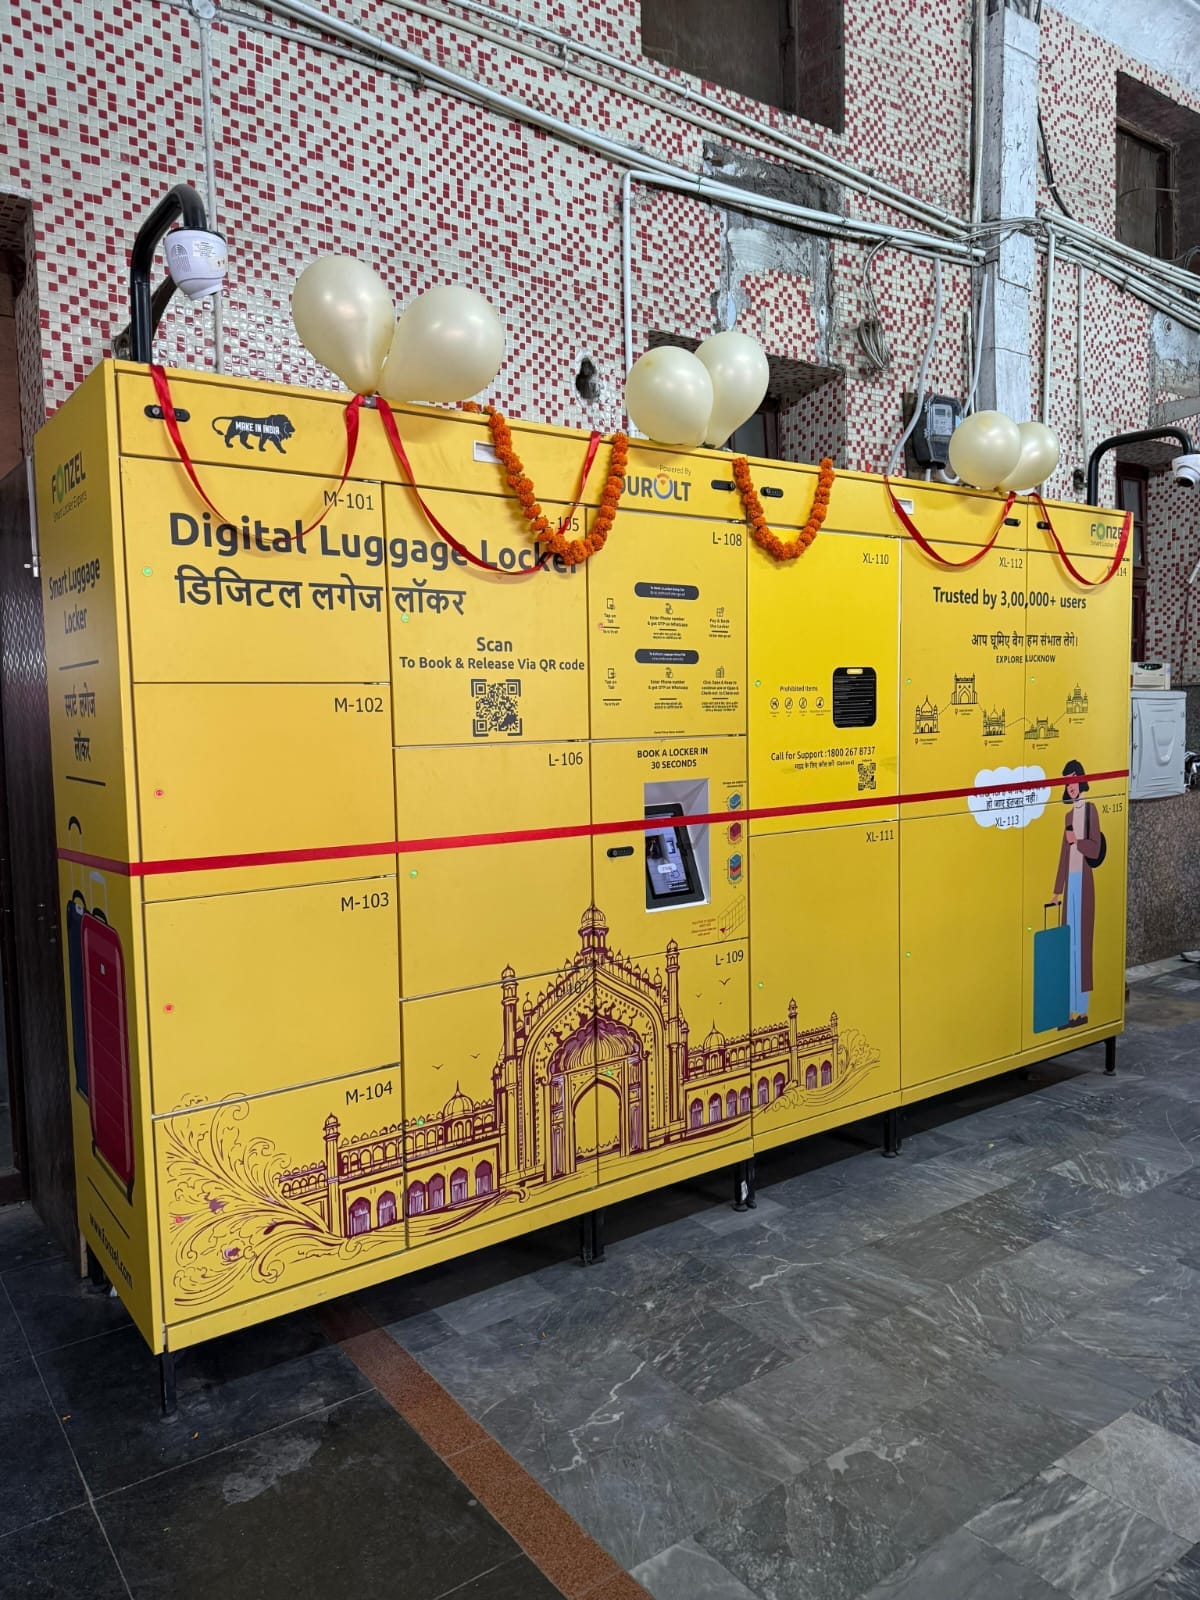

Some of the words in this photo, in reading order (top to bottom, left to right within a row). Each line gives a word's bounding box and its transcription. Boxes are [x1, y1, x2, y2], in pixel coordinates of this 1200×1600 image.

[235, 421, 254, 432] MAKE
[255, 423, 262, 433] IN
[263, 424, 280, 434] INDIA
[659, 464, 684, 475] Powered
[684, 467, 692, 477] By
[323, 490, 375, 511] M-101
[546, 516, 579, 532] -105
[1090, 522, 1124, 540] FONZE
[169, 511, 307, 557] Digital
[320, 525, 468, 571] Luggage
[712, 532, 743, 547] L-108
[862, 552, 889, 565] XL-110
[999, 556, 1023, 569] XL-112
[49, 570, 68, 601] Smart
[68, 557, 101, 595] Luggage
[174, 564, 303, 609] डिजिटल
[308, 573, 384, 613] लगेज
[391, 578, 467, 616] लॉकर
[933, 586, 979, 605] Trusted
[982, 588, 997, 610] by
[1000, 590, 1056, 609] 3,00,000+
[1060, 595, 1087, 609] users
[63, 602, 88, 635] Locker
[476, 636, 513, 653] Scan
[971, 633, 988, 647] आप
[990, 631, 1010, 650] घूमिए
[1012, 630, 1024, 647] बैग
[1025, 634, 1038, 648] हम
[1040, 632, 1061, 647] संभाल
[399, 656, 416, 669] To
[419, 656, 452, 669] Book
[455, 657, 464, 669] &
[468, 657, 515, 670] Release
[517, 658, 537, 670] Via
[539, 659, 556, 673] QR
[559, 659, 585, 671] code
[996, 655, 1024, 664] EXPLORE
[1024, 654, 1056, 663] LUCKNOW
[779, 685, 805, 693] Prohibited
[334, 697, 384, 713] M-102
[548, 751, 583, 767] L-106
[637, 749, 660, 758] BOOK
[661, 748, 668, 757] A
[669, 747, 699, 757] LOCKER
[700, 747, 708, 755] IN
[770, 752, 784, 761] Call
[785, 751, 796, 760] for
[797, 749, 824, 761] Support
[845, 747, 858, 757] 267
[859, 746, 876, 756] 8737
[651, 760, 661, 770] 30
[661, 758, 697, 769] SECONDS
[1102, 802, 1123, 814] XL-115
[995, 814, 1020, 828] XL-113
[865, 829, 895, 844] XL-111
[340, 891, 390, 913] M-103
[715, 949, 744, 966] L-109
[345, 1080, 393, 1106] M-104
